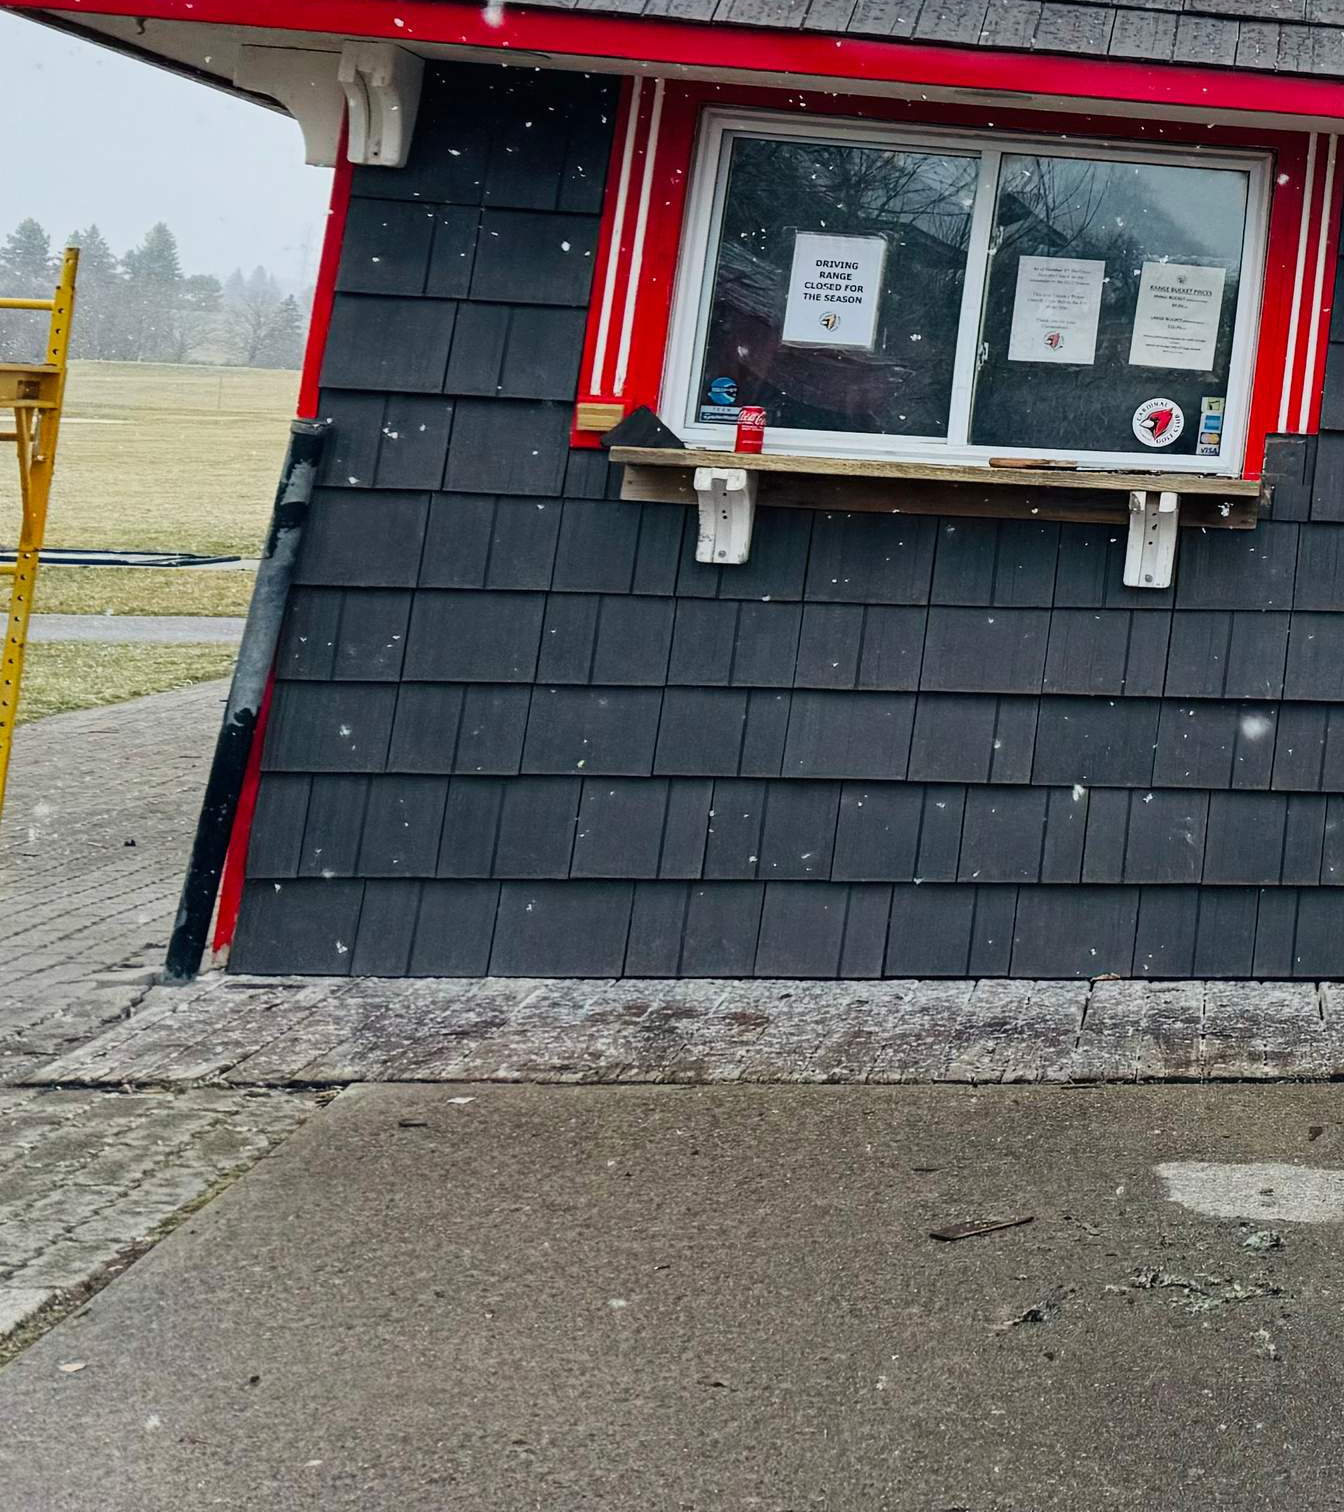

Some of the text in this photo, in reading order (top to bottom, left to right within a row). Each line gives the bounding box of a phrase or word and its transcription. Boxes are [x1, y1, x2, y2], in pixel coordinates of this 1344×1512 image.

[816, 259, 859, 270] DRIVING
[819, 271, 852, 280] RANGE
[804, 281, 864, 293] CLOSED FOR
[803, 292, 863, 304] THE SEASON
[1136, 401, 1168, 422] CARDINAL
[1156, 432, 1174, 444] GOLF
[1200, 447, 1217, 455] VISA
